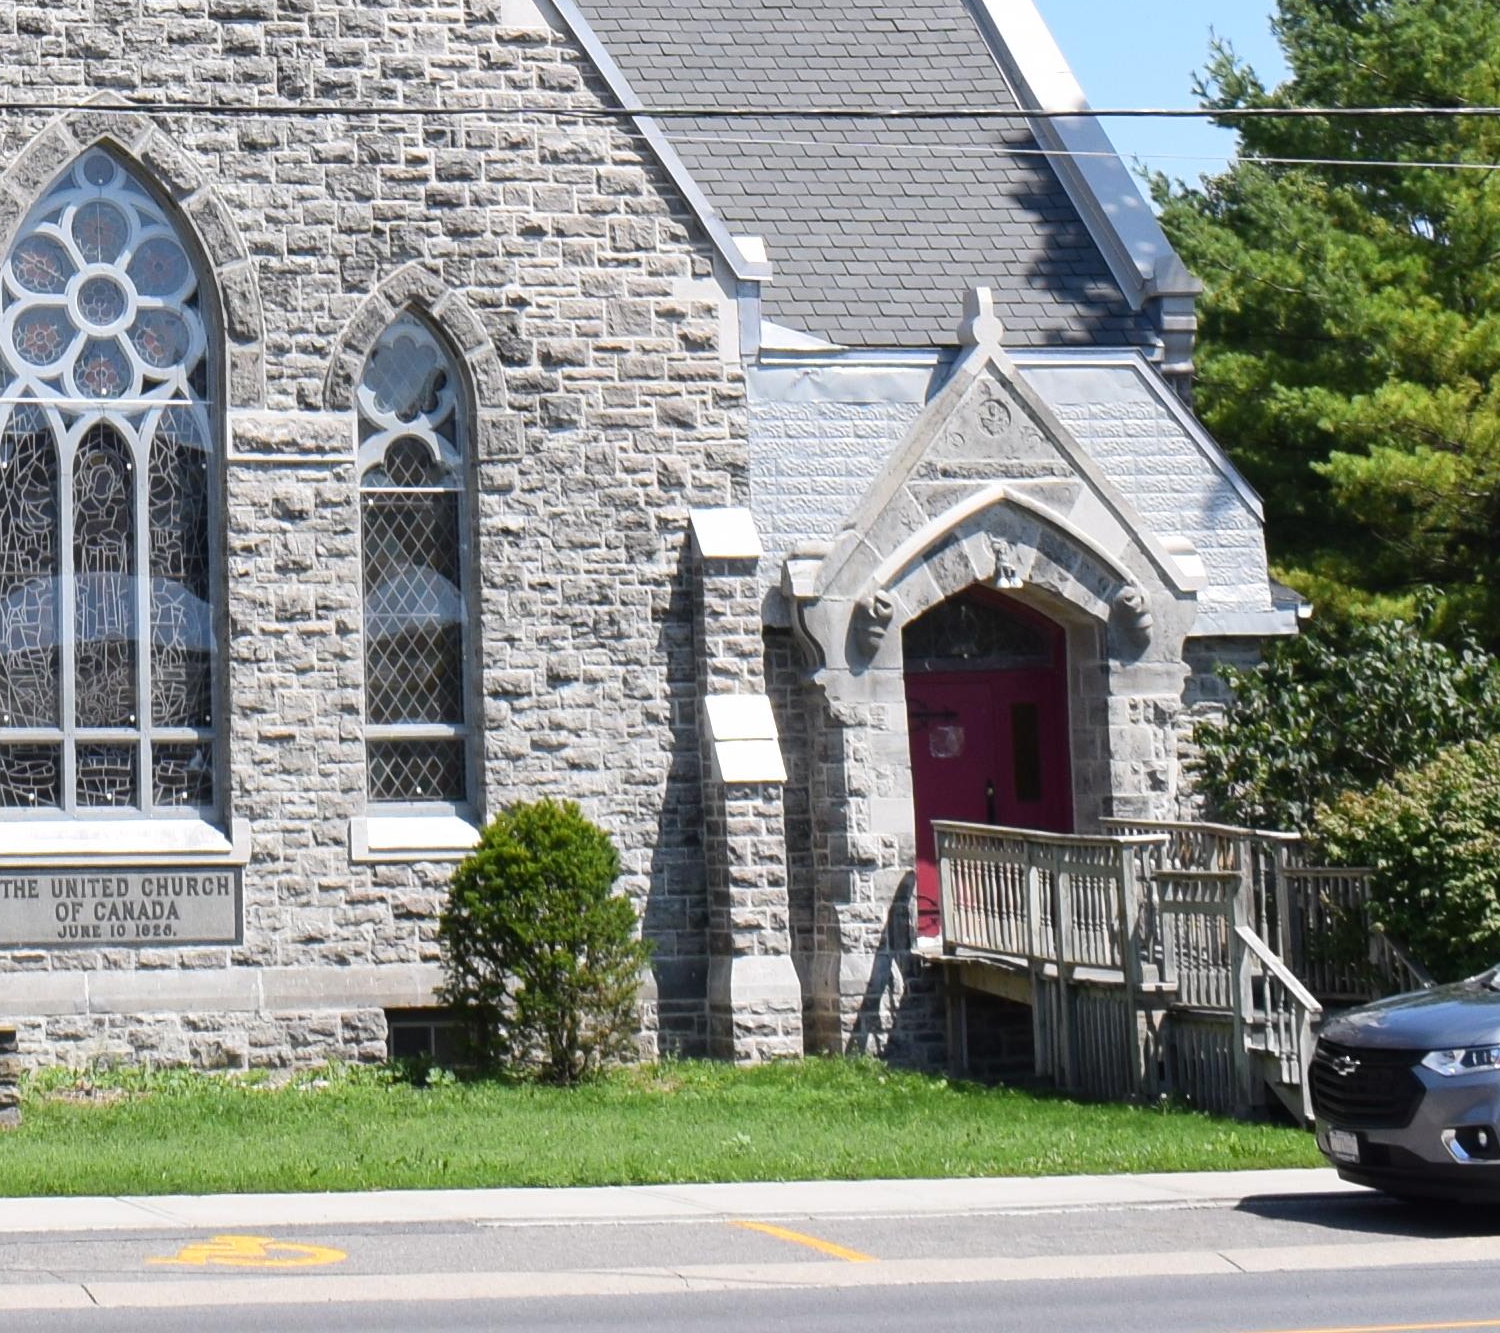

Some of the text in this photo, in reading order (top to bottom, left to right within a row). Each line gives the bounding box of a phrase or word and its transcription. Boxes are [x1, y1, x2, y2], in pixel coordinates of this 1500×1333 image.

[0, 876, 229, 899] THE UNITED CHURCH
[55, 900, 180, 922] OF CANADA
[57, 924, 102, 939] JUNE
[110, 923, 126, 937] 10
